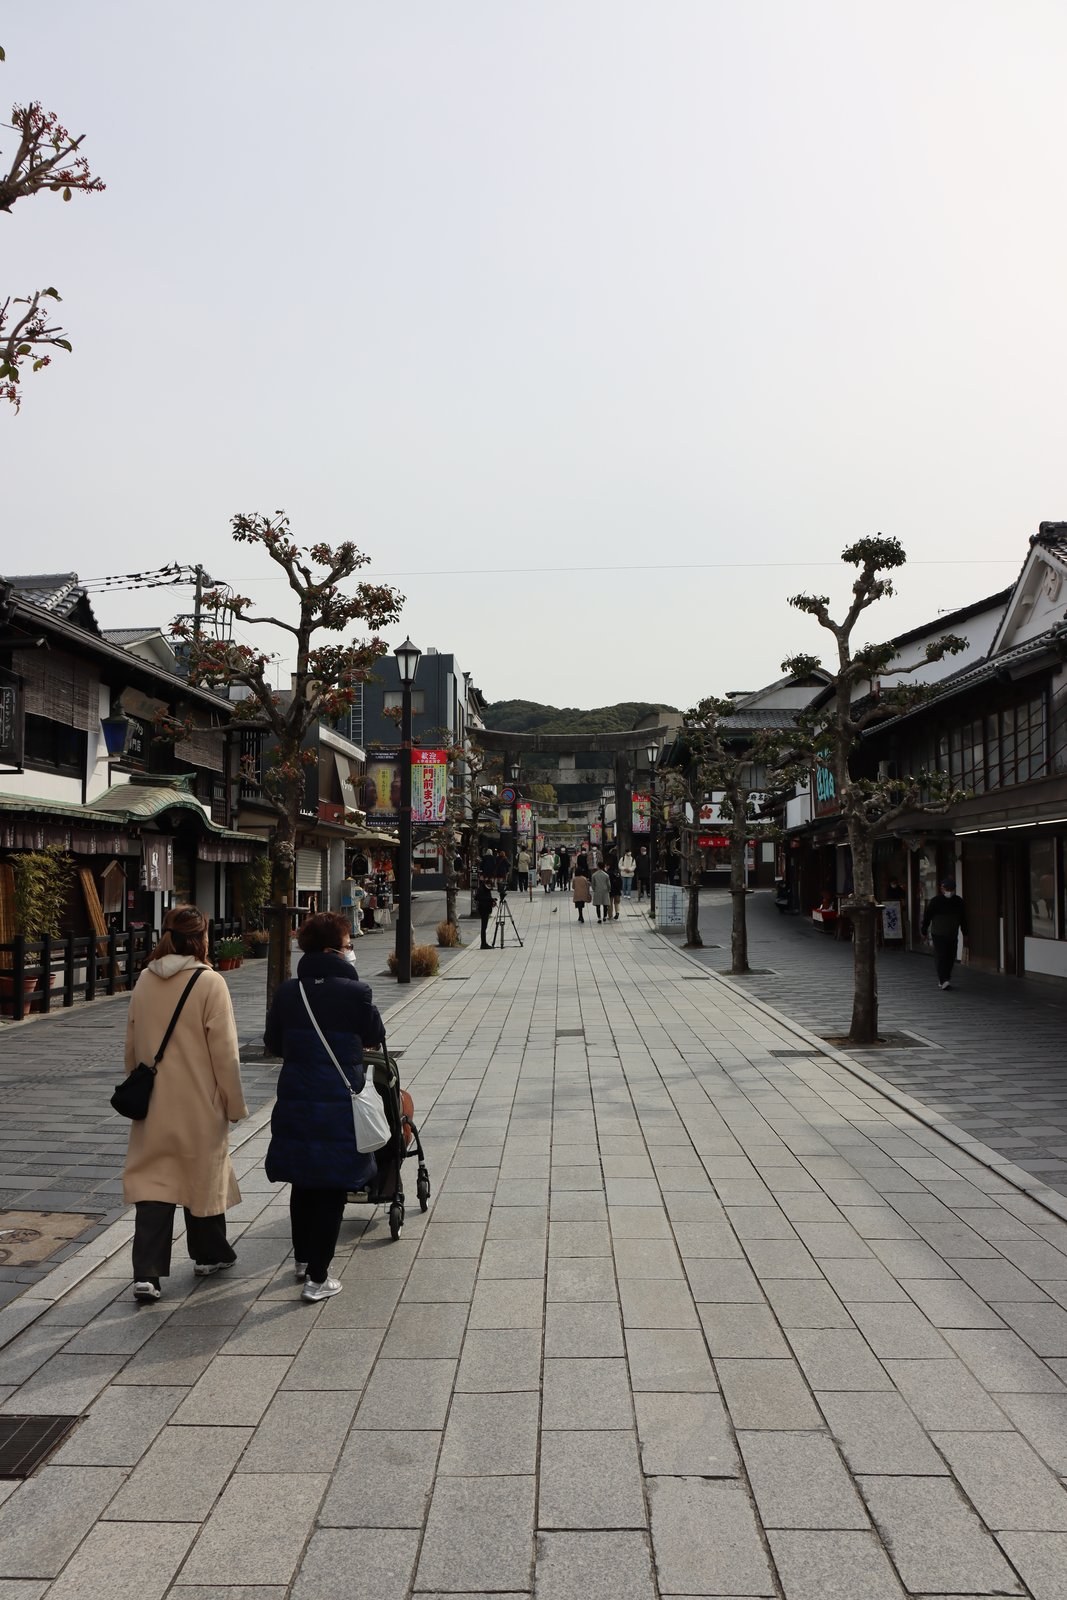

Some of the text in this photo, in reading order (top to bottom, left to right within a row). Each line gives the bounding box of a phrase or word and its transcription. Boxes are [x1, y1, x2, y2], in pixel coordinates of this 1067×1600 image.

[423, 768, 434, 819] 門前まつり
